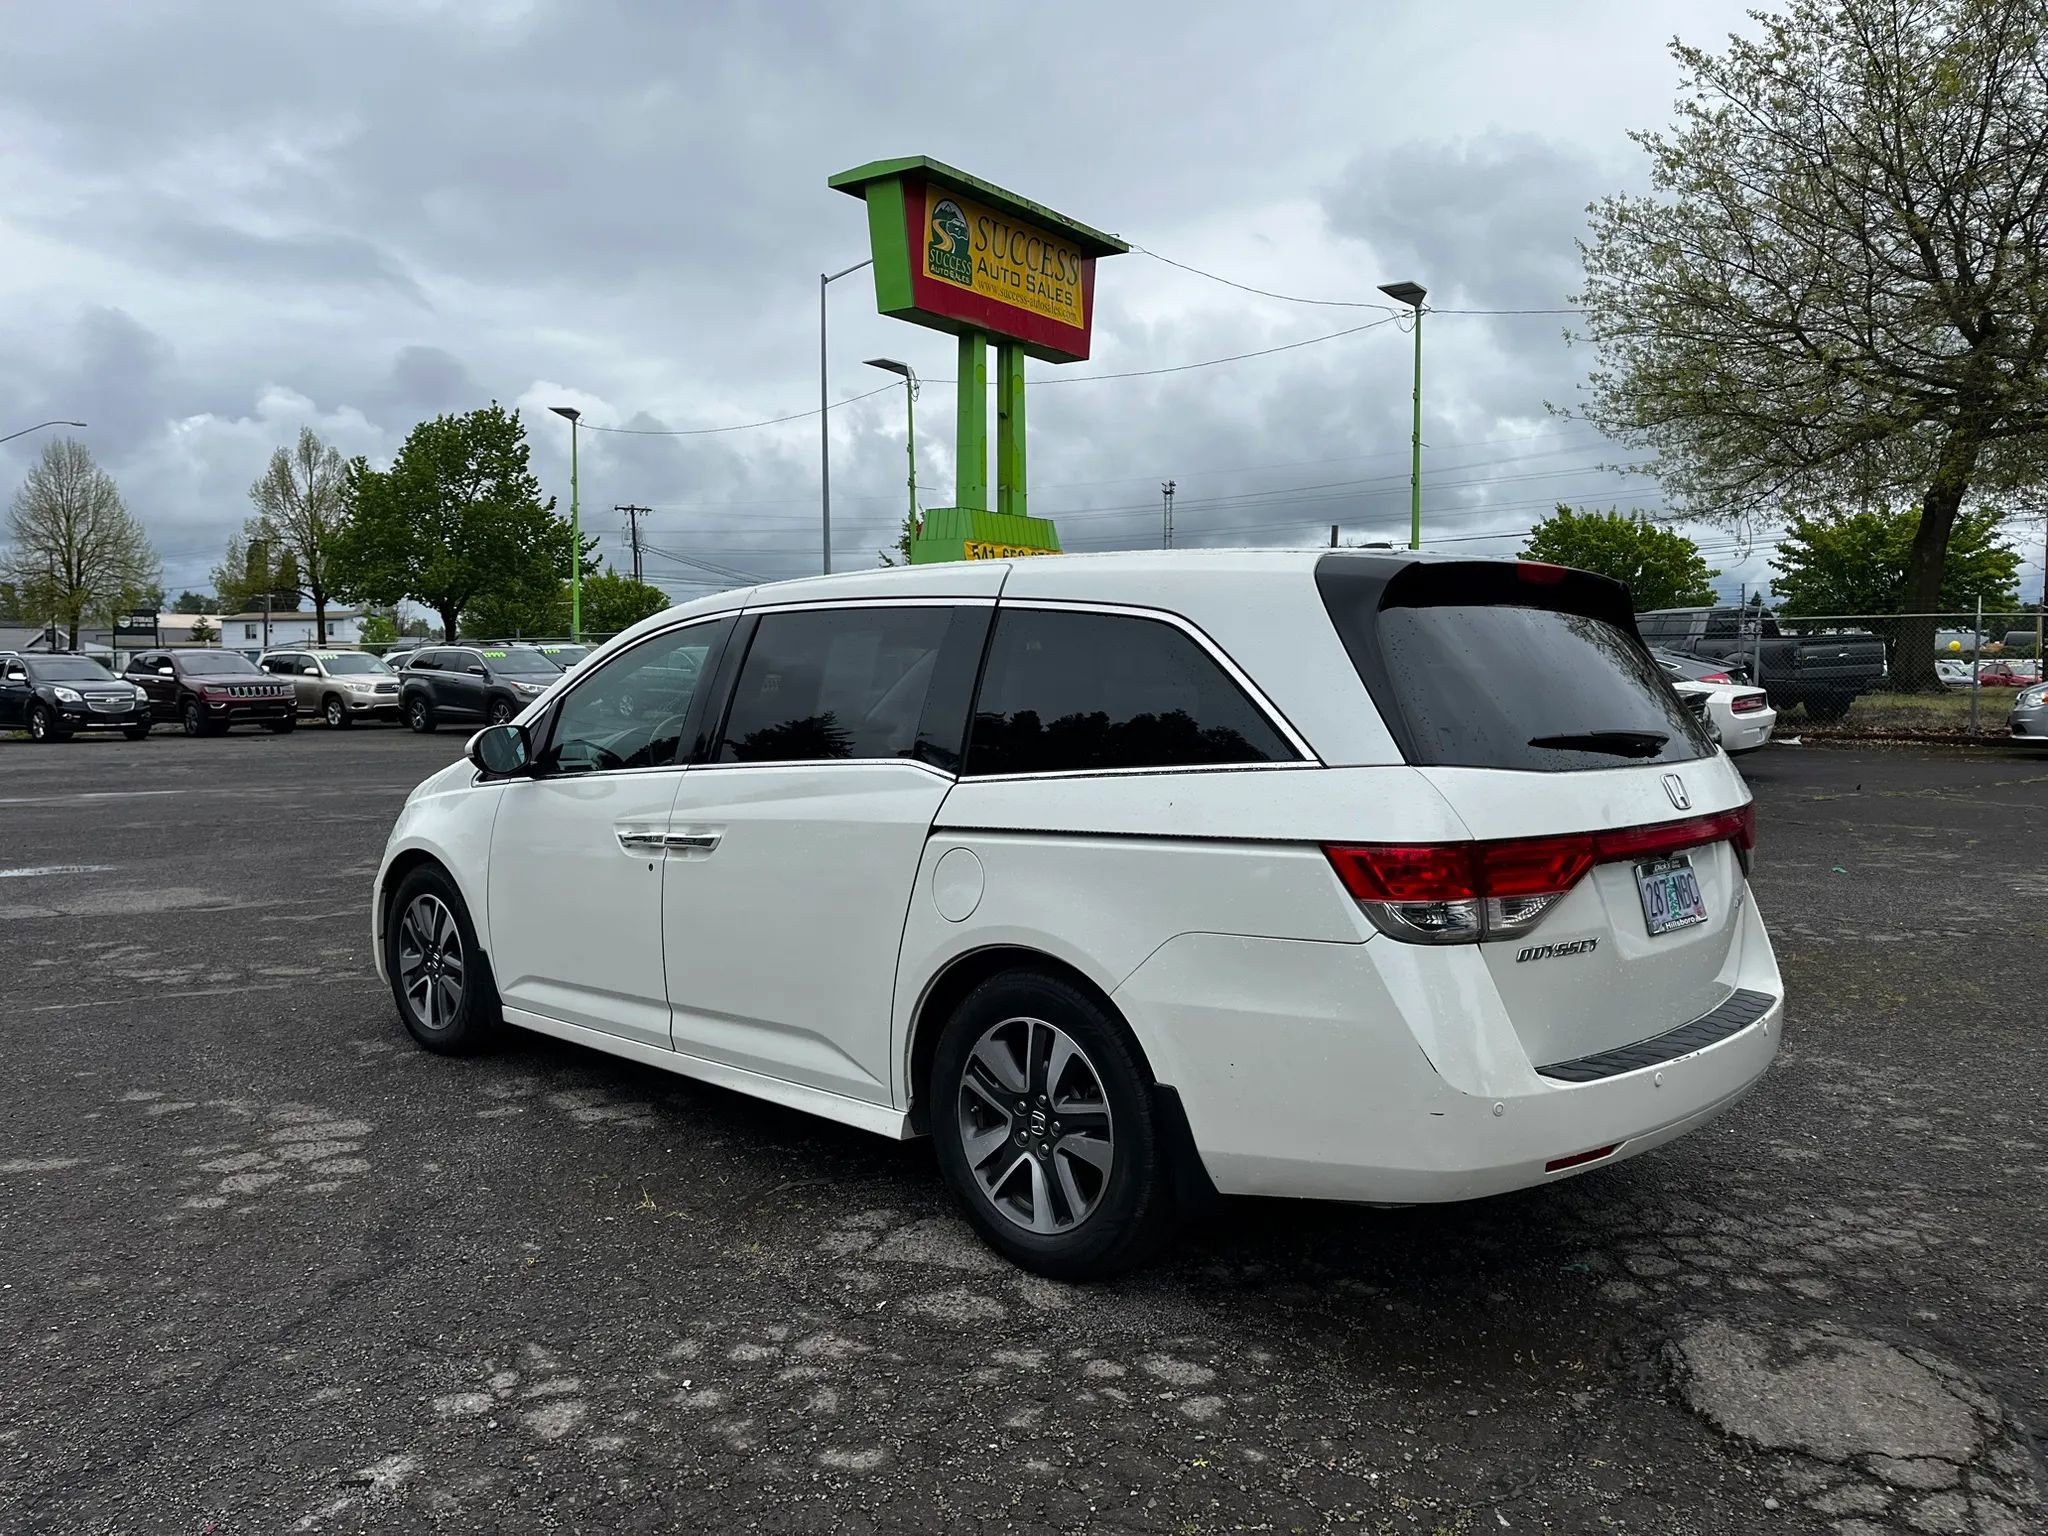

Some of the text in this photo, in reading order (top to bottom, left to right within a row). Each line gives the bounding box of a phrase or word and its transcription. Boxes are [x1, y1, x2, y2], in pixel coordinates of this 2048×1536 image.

[930, 249, 972, 275] SUCCESS
[975, 216, 1079, 286] SUCCESS
[977, 257, 1073, 307] AUTO SALES
[1645, 873, 1699, 917] 287 NBC
[1665, 916, 1696, 930] Hillsboro
[1516, 938, 1601, 963] ODYSSEY
